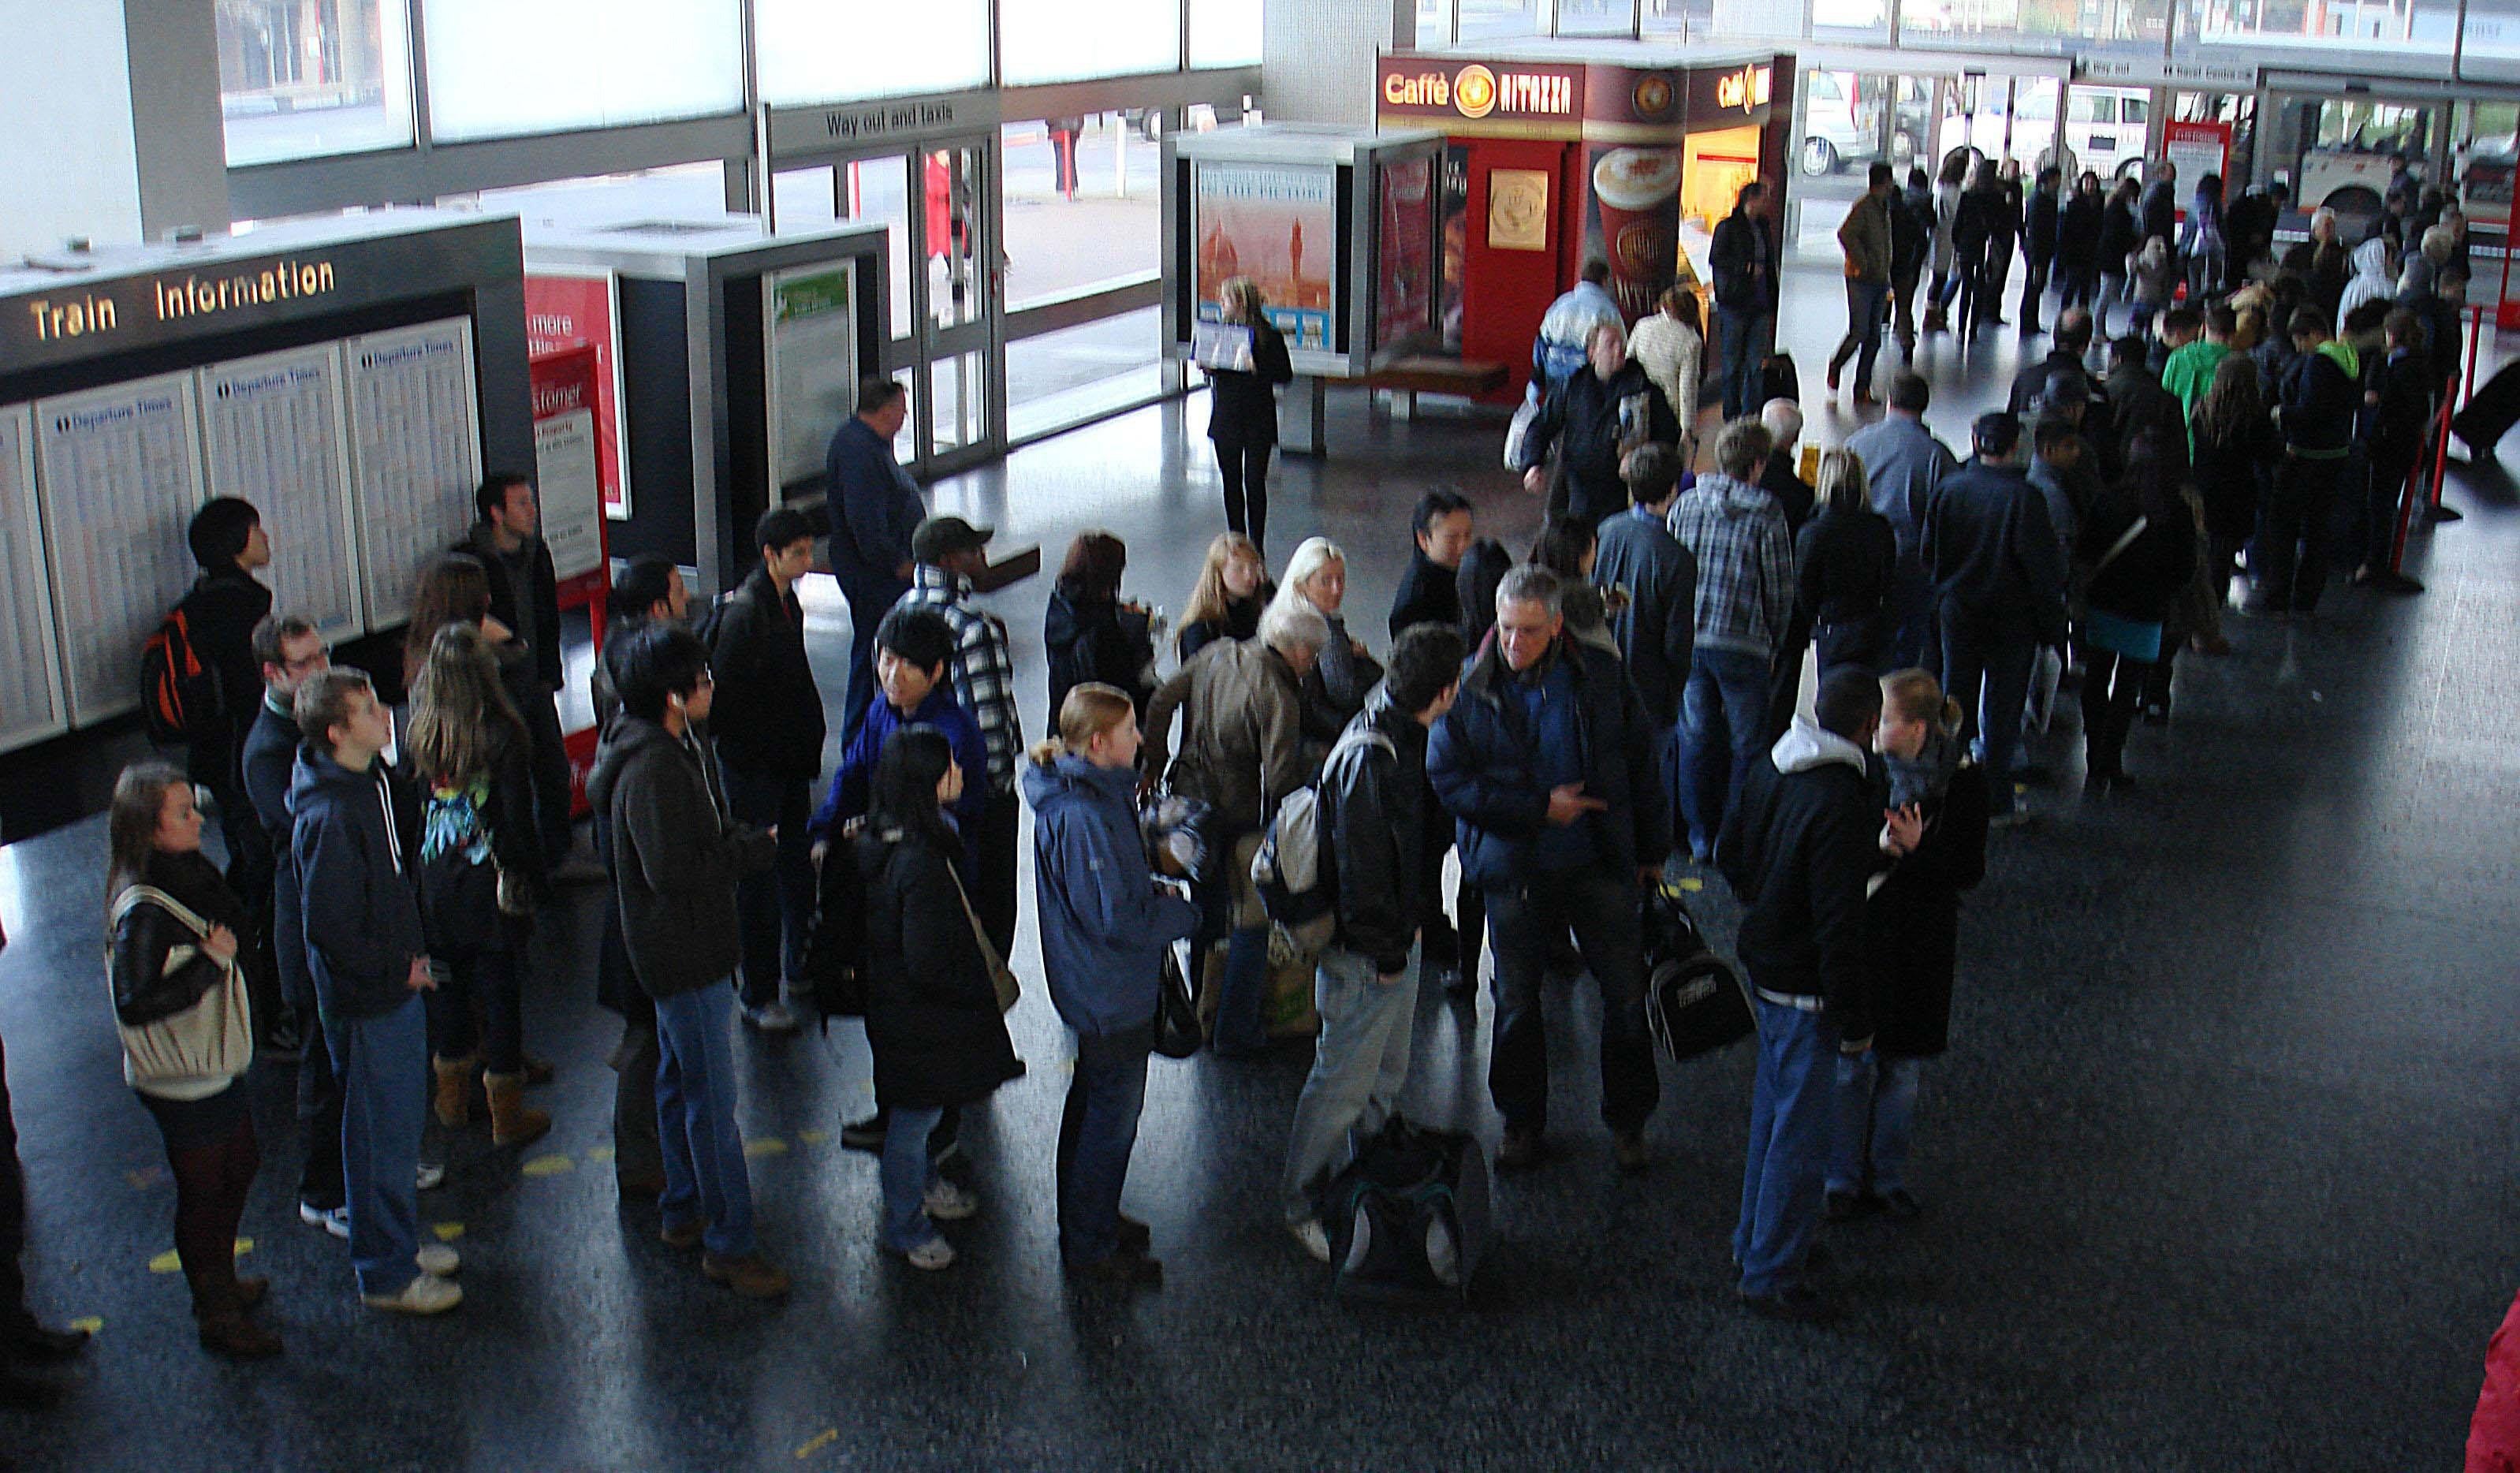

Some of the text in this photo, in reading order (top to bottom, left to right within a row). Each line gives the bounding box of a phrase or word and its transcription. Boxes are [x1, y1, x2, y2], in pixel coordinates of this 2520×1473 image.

[2093, 60, 2111, 75] Way
[1385, 72, 1572, 114] Caffè RITAZZA
[827, 99, 953, 139] Way out and taxis
[30, 260, 335, 341] Train Information
[532, 314, 572, 337] more
[532, 382, 583, 416] stomer
